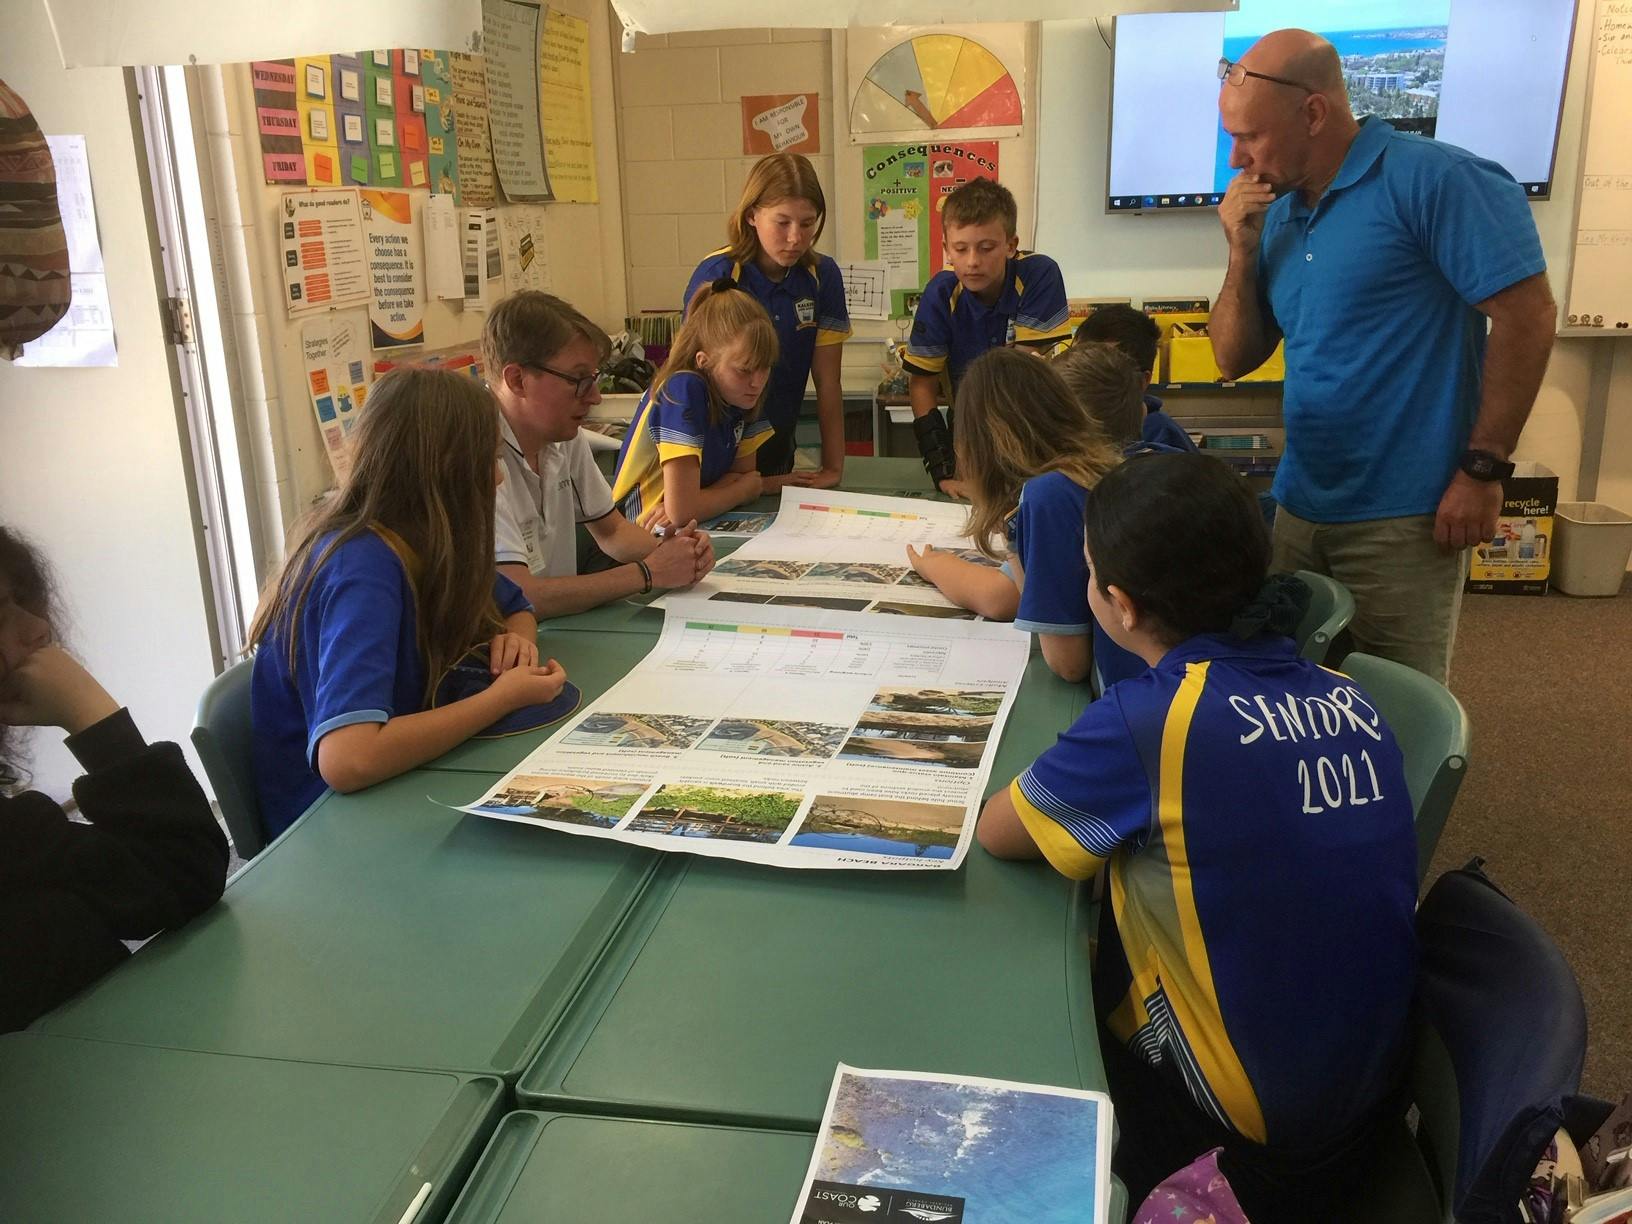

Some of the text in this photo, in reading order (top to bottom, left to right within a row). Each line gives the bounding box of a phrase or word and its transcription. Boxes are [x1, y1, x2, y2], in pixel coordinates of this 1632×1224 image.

[254, 69, 296, 85] WEDNESDAY
[770, 99, 804, 117] RESPONSIBLE
[262, 116, 297, 128] THURSDAY
[777, 117, 789, 126] FOR
[774, 131, 806, 149] BEHAVIOUR
[272, 161, 297, 172] FRIDAY
[866, 145, 996, 179] Consequences
[316, 200, 326, 208] good
[369, 233, 408, 245] Every action we
[374, 246, 393, 257] choose
[394, 247, 403, 257] has
[370, 262, 404, 271] consequence.
[374, 274, 386, 283] best
[392, 272, 412, 283] consider
[374, 286, 414, 297] the consequence
[378, 299, 414, 310] before we take
[305, 338, 329, 350] Strategies
[306, 349, 328, 360] Together
[1504, 498, 1550, 508] recycle
[1524, 506, 1548, 515] here!
[1229, 686, 1381, 744] SENIORS
[1298, 749, 1384, 813] 2021
[814, 1191, 858, 1202] COAST
[838, 1200, 856, 1208] OUR
[906, 1201, 953, 1212] BUNDABERG
